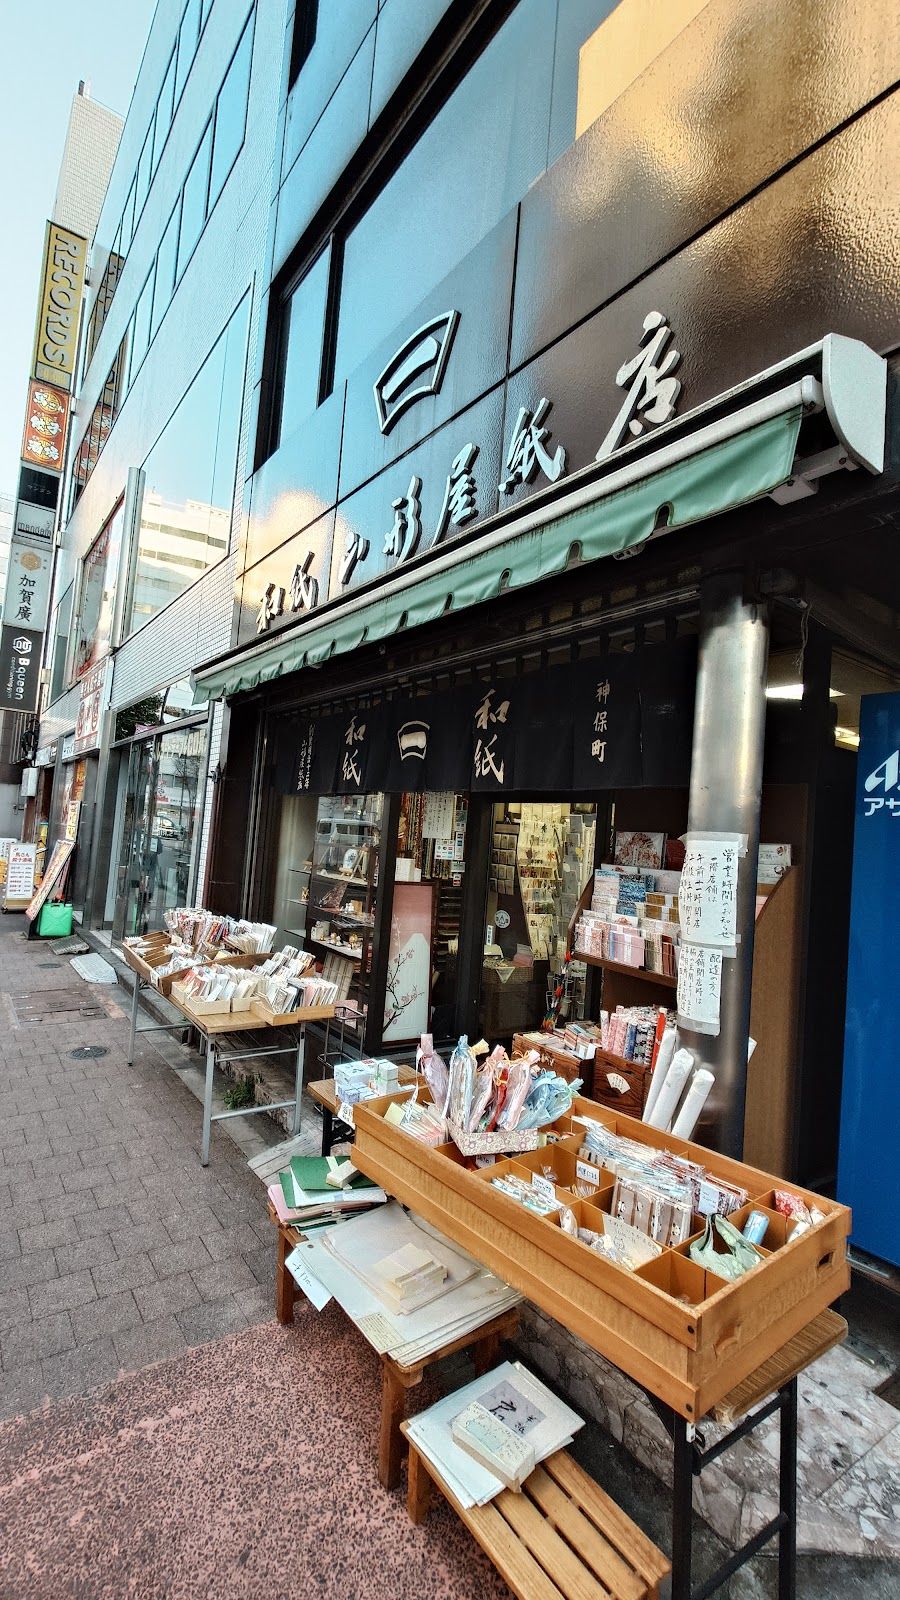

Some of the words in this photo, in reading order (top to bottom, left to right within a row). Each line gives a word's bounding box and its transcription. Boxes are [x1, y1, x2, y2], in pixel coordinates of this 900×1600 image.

[42, 233, 78, 368] RECORDS
[256, 551, 319, 634] 和紙
[342, 716, 367, 787] 和紙
[474, 688, 511, 784] 和紙
[592, 679, 610, 762] 神保町
